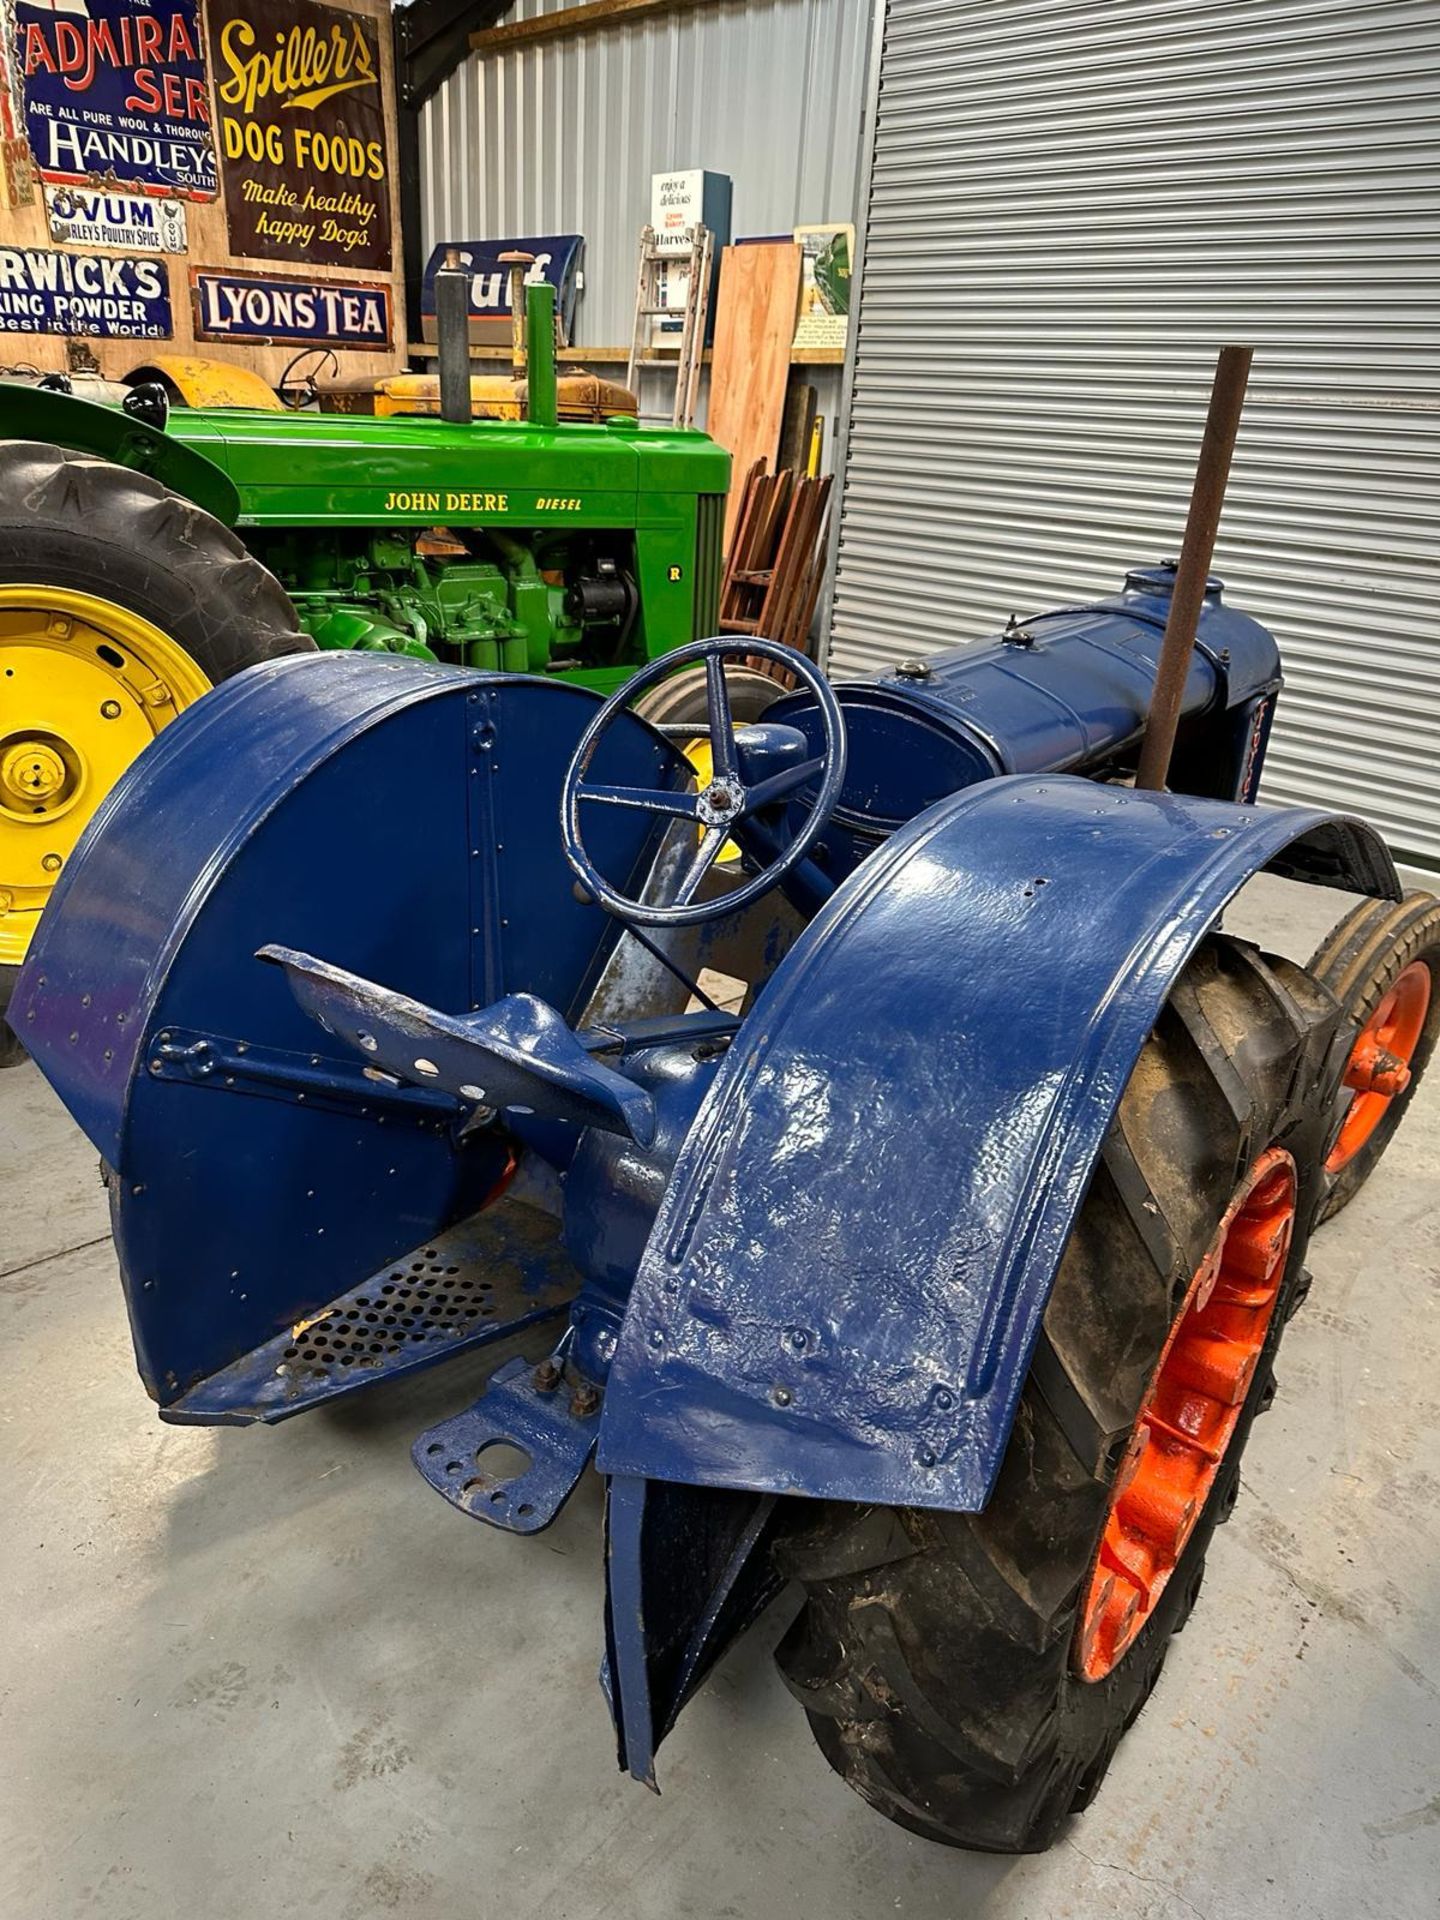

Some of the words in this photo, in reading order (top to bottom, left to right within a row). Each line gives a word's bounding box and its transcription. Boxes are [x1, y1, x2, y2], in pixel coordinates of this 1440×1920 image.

[220, 18, 378, 113] Spillers
[30, 100, 53, 116] ARE
[59, 109, 79, 121] ALL
[84, 110, 113, 126] PURE
[119, 116, 149, 131] WOOL
[153, 122, 162, 133] &
[223, 117, 284, 165] DOG
[294, 128, 385, 180] FOODS
[176, 171, 215, 187] SOUTH
[242, 179, 298, 206] Make
[53, 192, 155, 227] OVUM
[101, 225, 136, 245] POULTRY
[137, 228, 161, 247] SPICE
[255, 211, 316, 248] happy
[54, 296, 148, 321] POWDER
[204, 279, 318, 330] LYONS'
[320, 288, 384, 335] TEA
[385, 492, 440, 511] JOHN
[447, 493, 509, 512] DEERE
[536, 498, 582, 511] DIESEL
[670, 567, 680, 580] R
